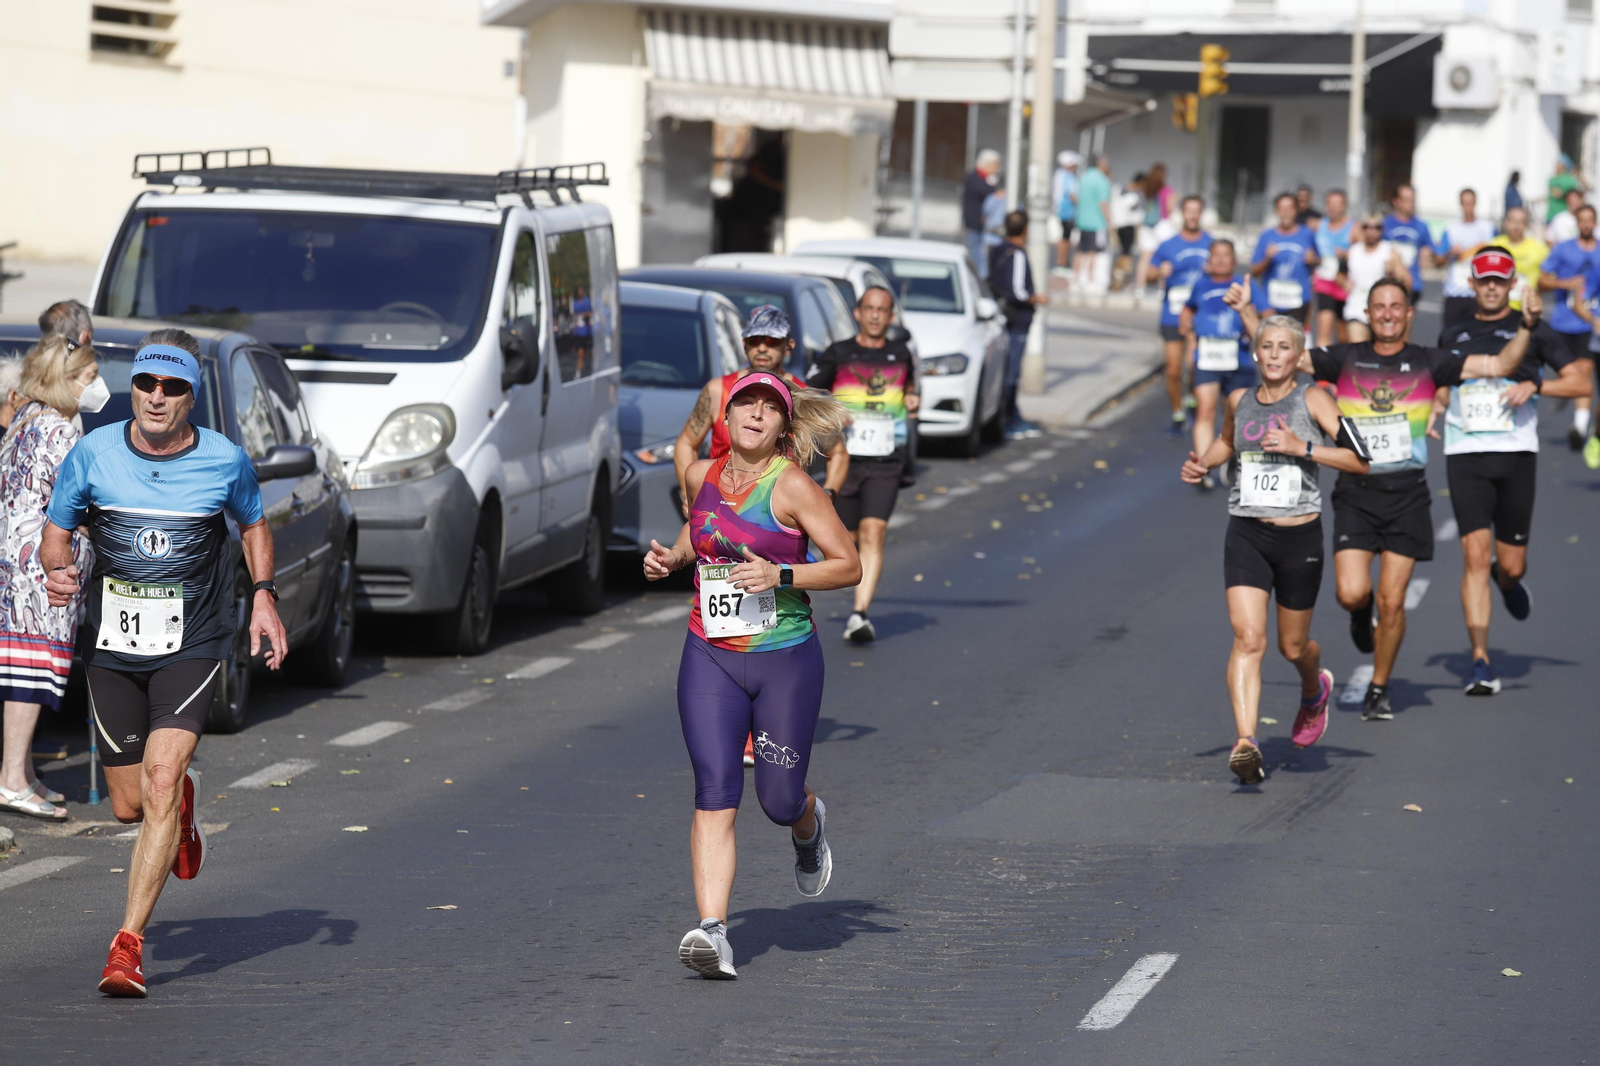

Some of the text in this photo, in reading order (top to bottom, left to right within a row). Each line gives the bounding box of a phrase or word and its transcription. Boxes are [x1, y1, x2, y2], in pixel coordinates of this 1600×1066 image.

[1467, 403, 1493, 418] 269
[1253, 474, 1279, 491] 102
[709, 568, 730, 579] VUELTA
[115, 583, 138, 597] VUELTA
[139, 587, 146, 597] A
[709, 592, 744, 618] 657
[120, 610, 140, 636] 81
